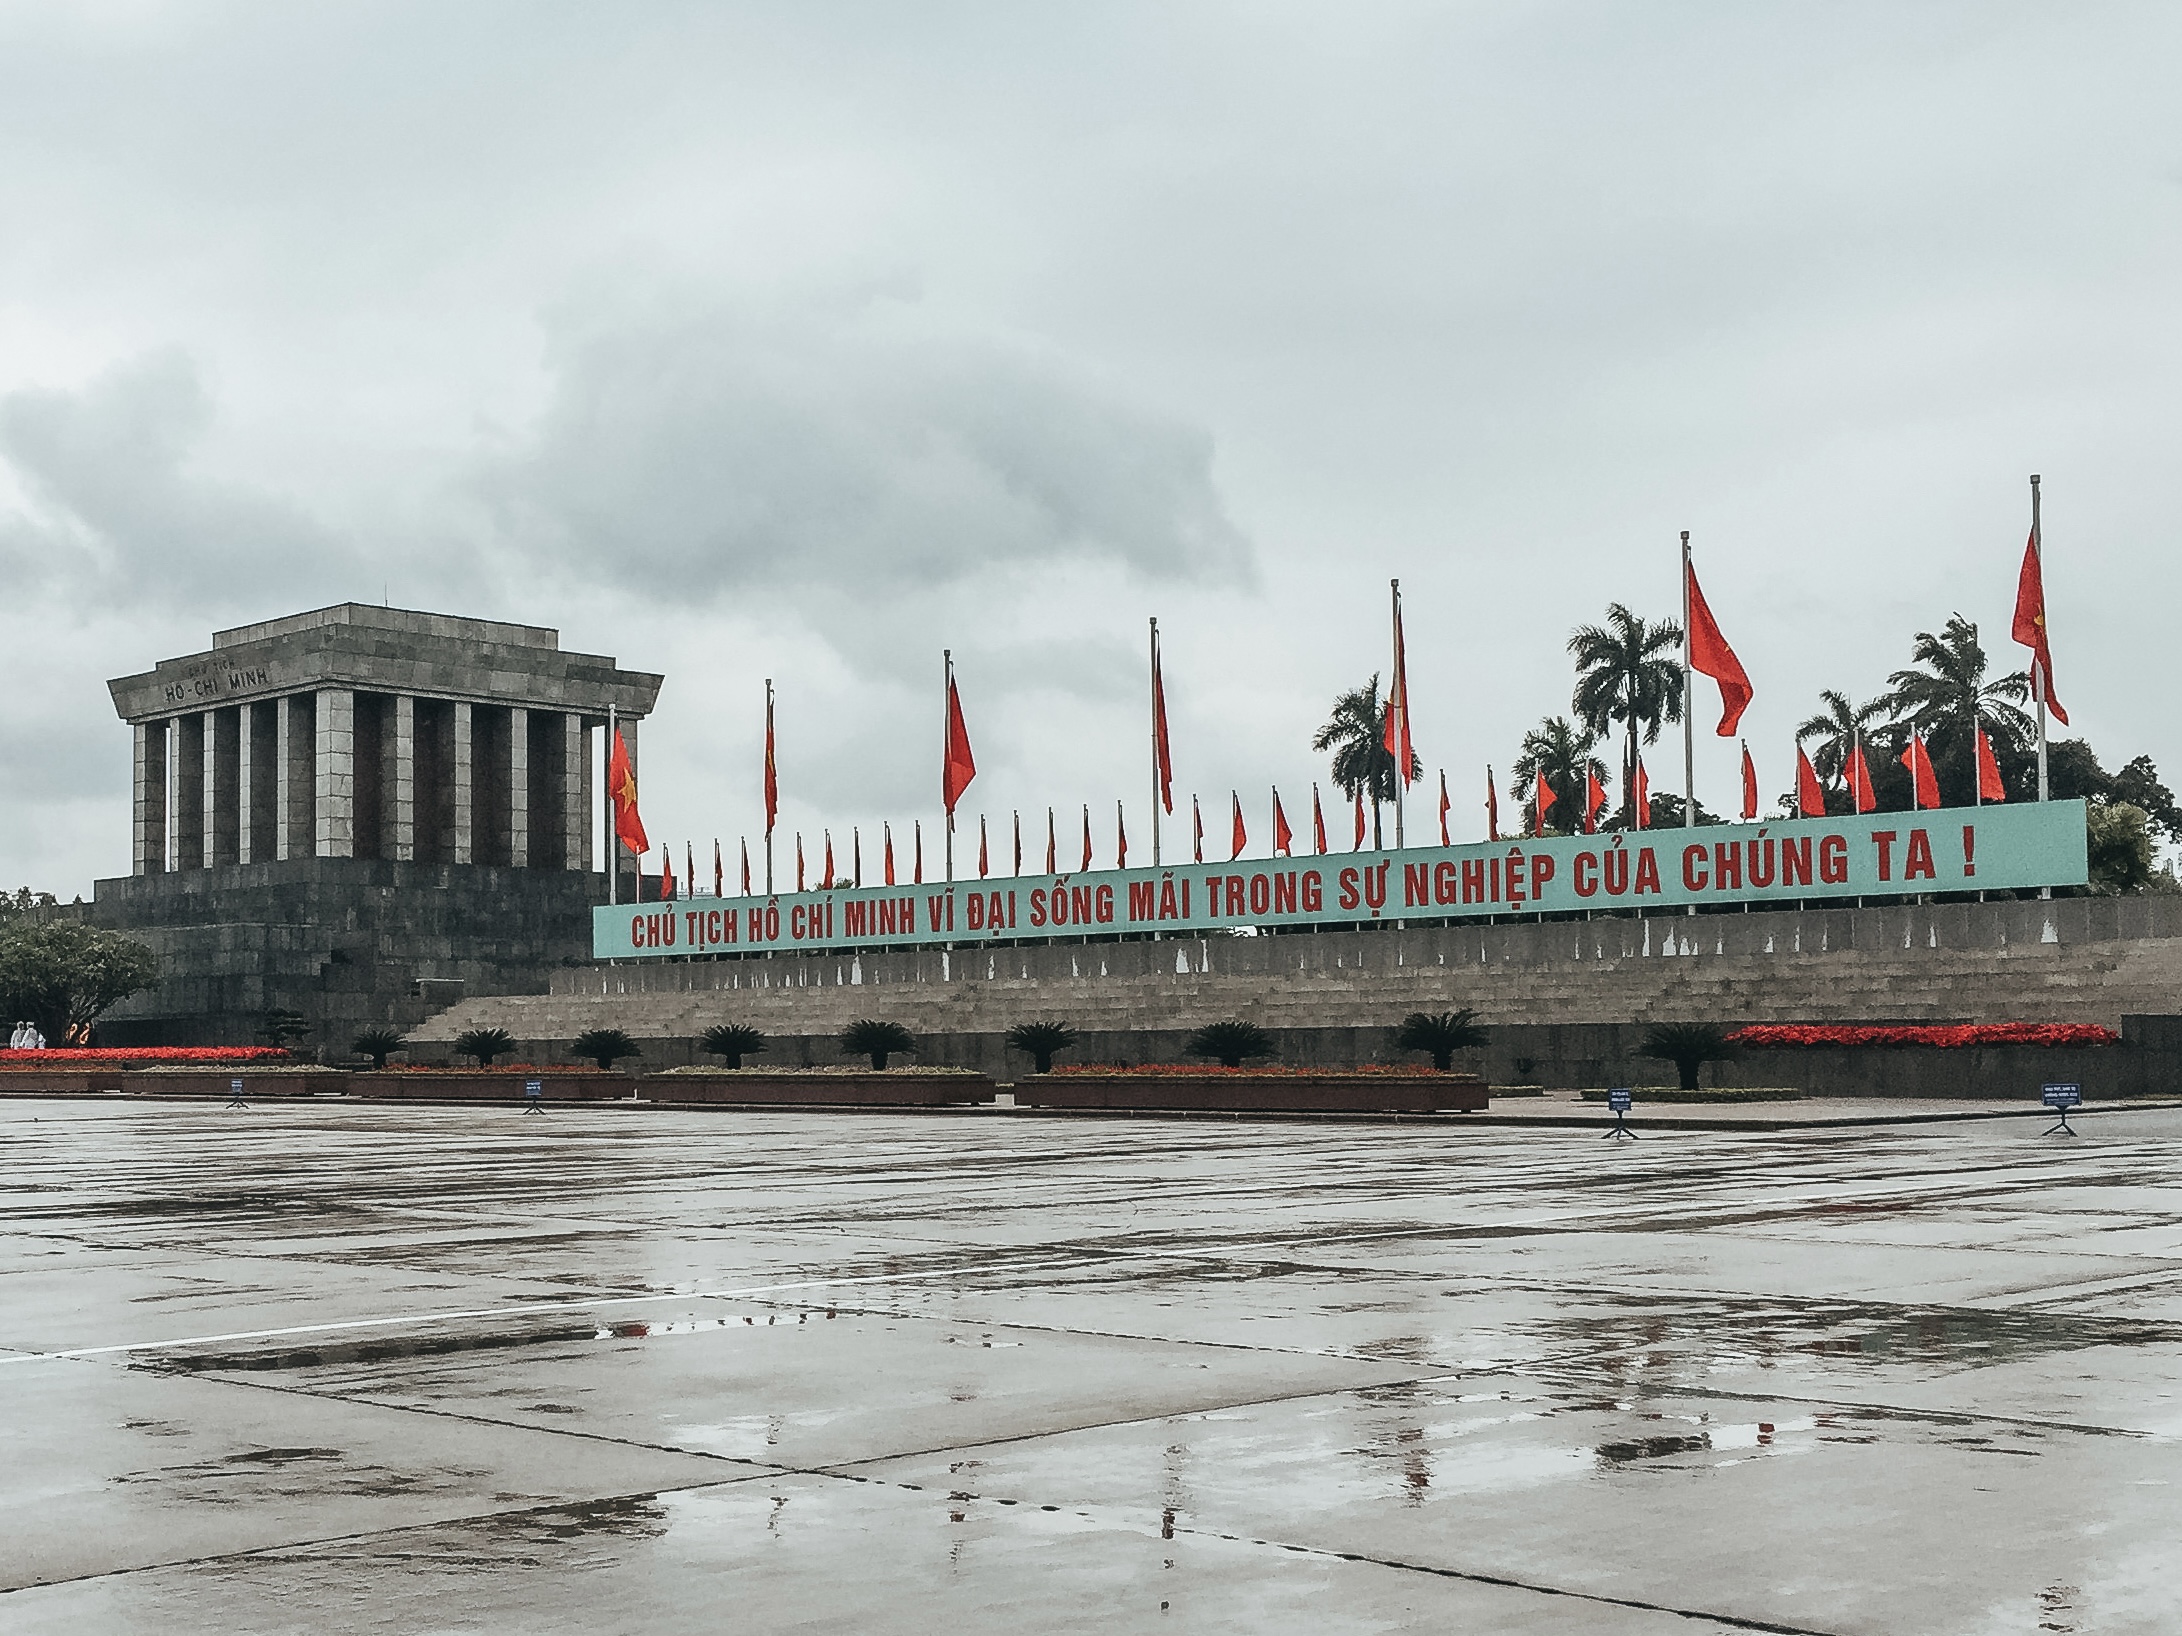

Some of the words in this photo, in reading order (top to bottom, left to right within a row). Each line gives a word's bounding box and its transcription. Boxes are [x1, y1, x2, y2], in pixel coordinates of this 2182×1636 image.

[228, 667, 269, 690] MINH
[632, 903, 676, 947] CHỦ
[686, 911, 737, 951] TỊCH
[748, 895, 780, 941] HỒ
[791, 895, 832, 939] CHÍ
[845, 898, 914, 937] MINH
[928, 887, 953, 932] VĨ
[967, 892, 1016, 936] ĐẠI
[1031, 874, 1114, 927] SỐNG
[1129, 871, 1190, 921] MÃI
[1206, 871, 1323, 917] TRONG
[1339, 860, 1391, 917] SỰ
[1404, 847, 1555, 909] NGHIỆP
[1574, 836, 1661, 897] CỦA
[1683, 830, 1848, 891] CHÚNG
[1872, 829, 1935, 881] TA
